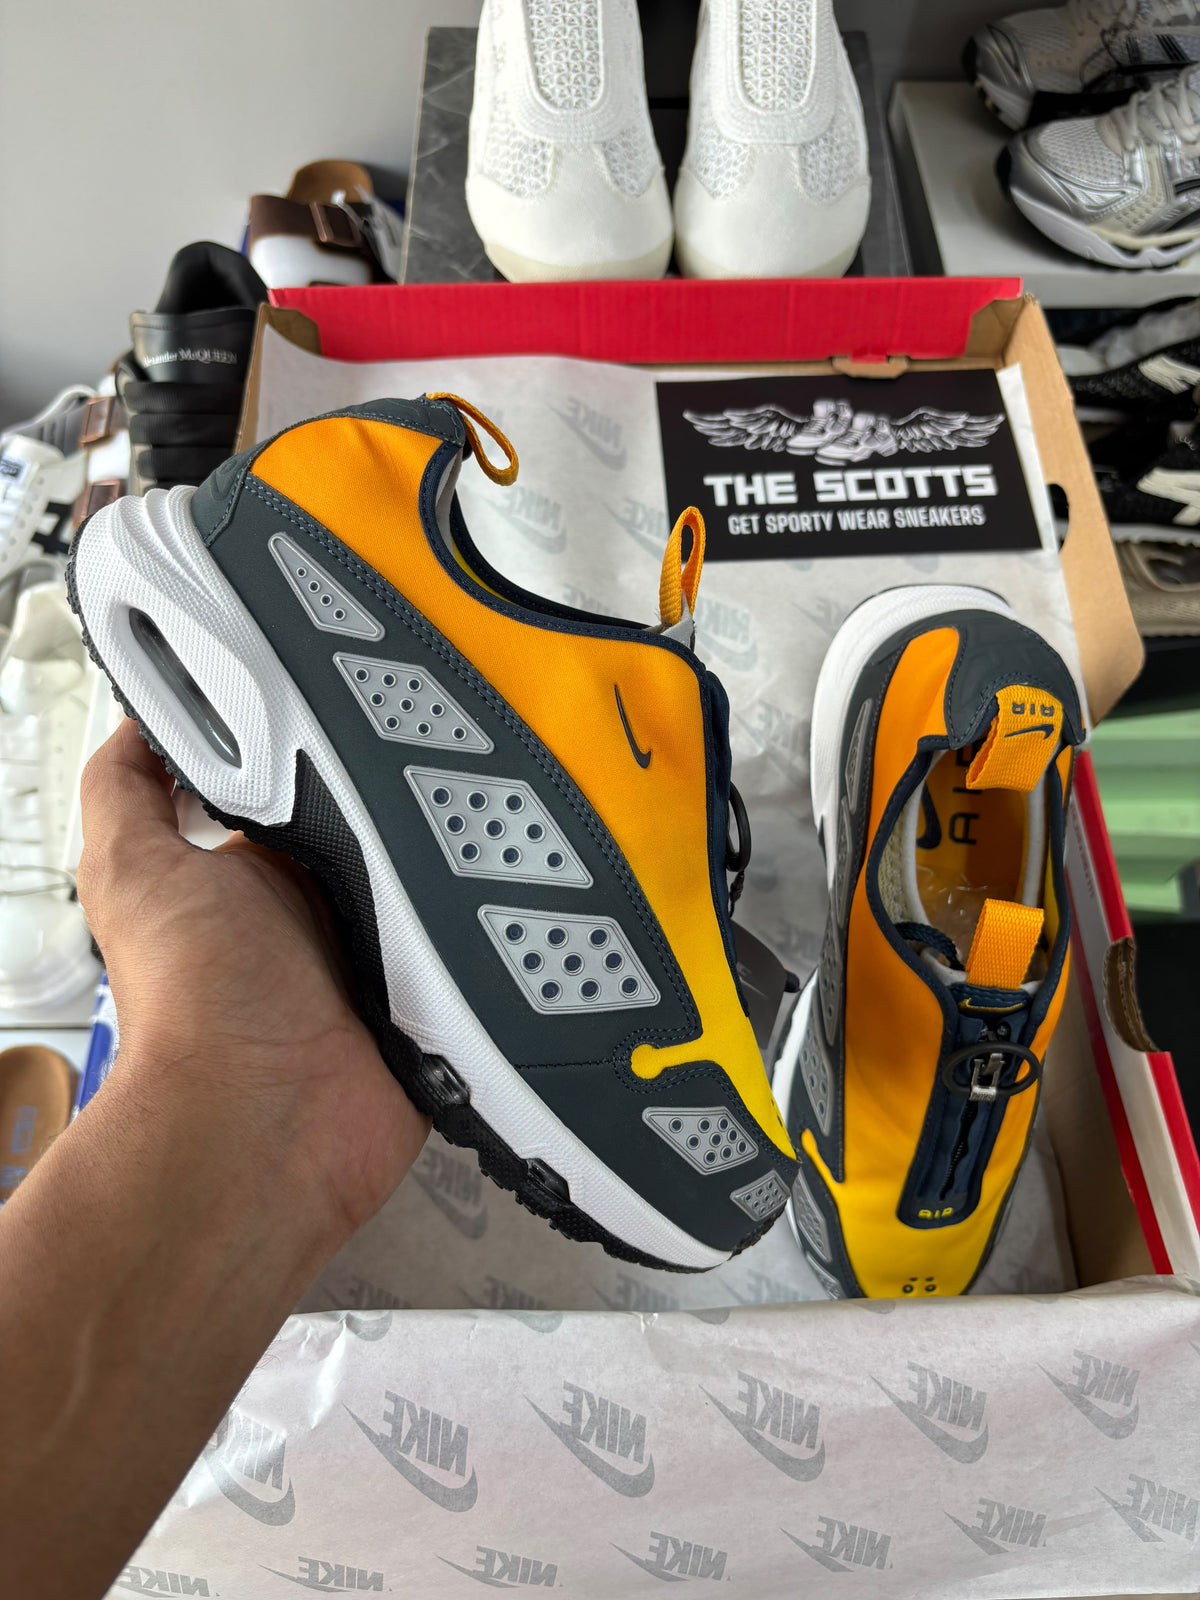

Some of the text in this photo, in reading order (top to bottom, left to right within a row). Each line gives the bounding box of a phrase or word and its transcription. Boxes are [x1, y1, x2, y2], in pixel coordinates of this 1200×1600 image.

[703, 464, 998, 507] THE SCOTTS
[728, 504, 986, 535] GET SPORTY WEAR SNEAKERS
[1011, 702, 1055, 717] AIR
